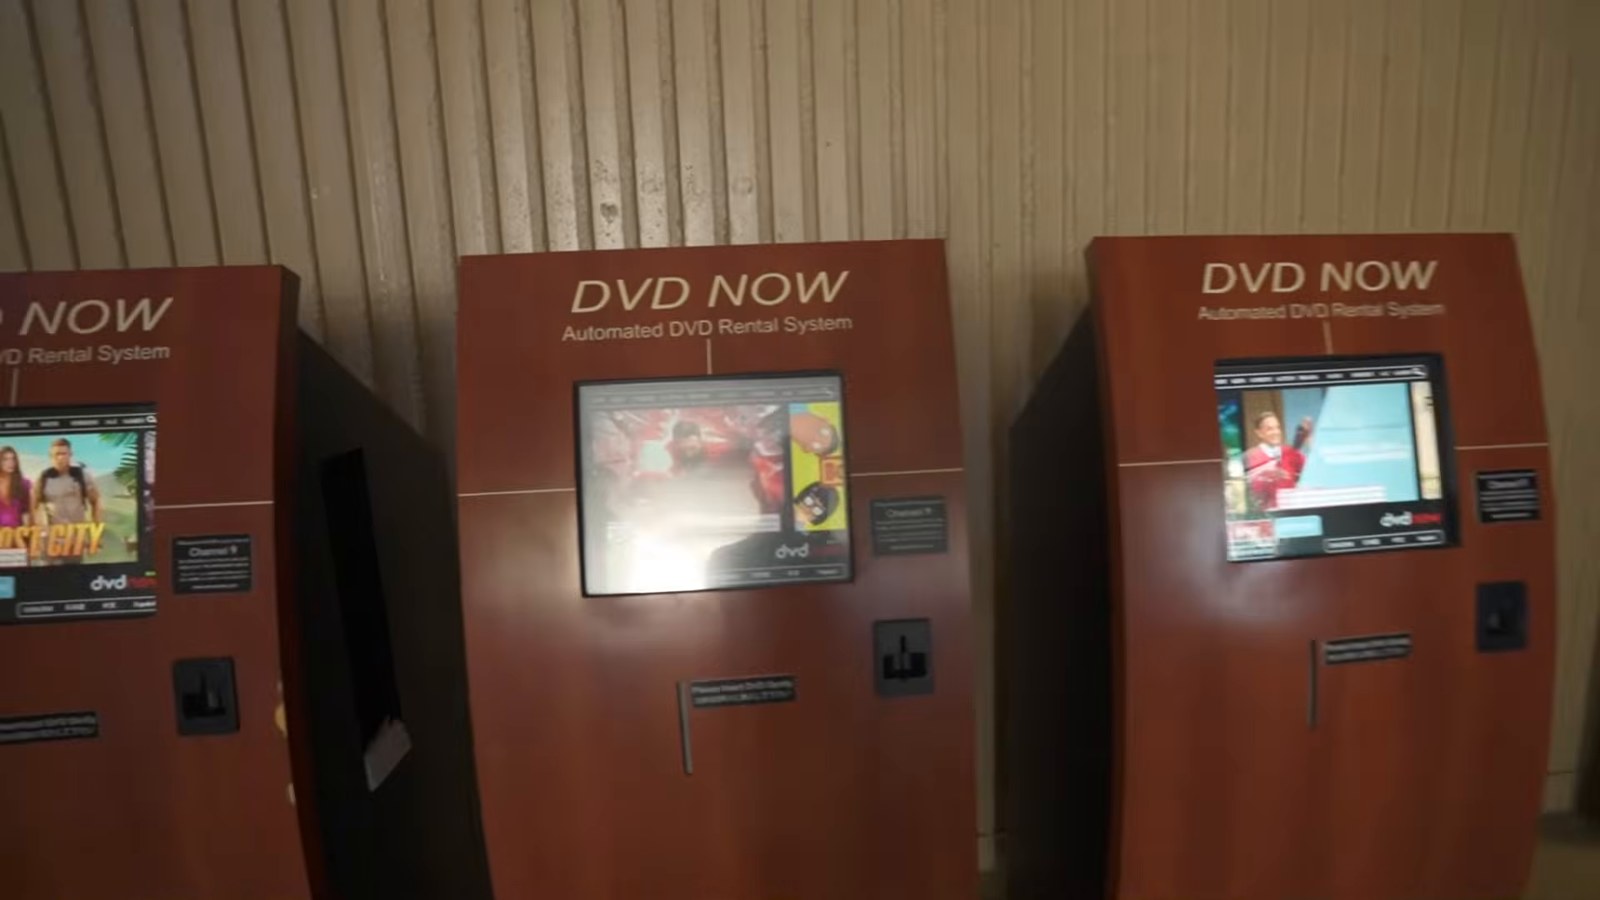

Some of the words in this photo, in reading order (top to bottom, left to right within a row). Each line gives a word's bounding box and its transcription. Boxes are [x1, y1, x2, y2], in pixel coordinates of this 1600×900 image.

[571, 276, 690, 313] DVD
[707, 270, 849, 308] NOW
[1202, 262, 1306, 294] DVD
[1320, 260, 1438, 292] NOW
[18, 297, 174, 336] NOW
[562, 322, 663, 341] Automated
[669, 319, 713, 337] DVD
[718, 317, 778, 335] Rental
[783, 315, 853, 335] System
[1198, 305, 1287, 321] Automated
[1290, 303, 1330, 319] DVD
[1332, 302, 1383, 317] Rental
[1386, 301, 1446, 319] System
[27, 346, 92, 364] Rental
[97, 344, 170, 365] System
[47, 521, 105, 557] CITY
